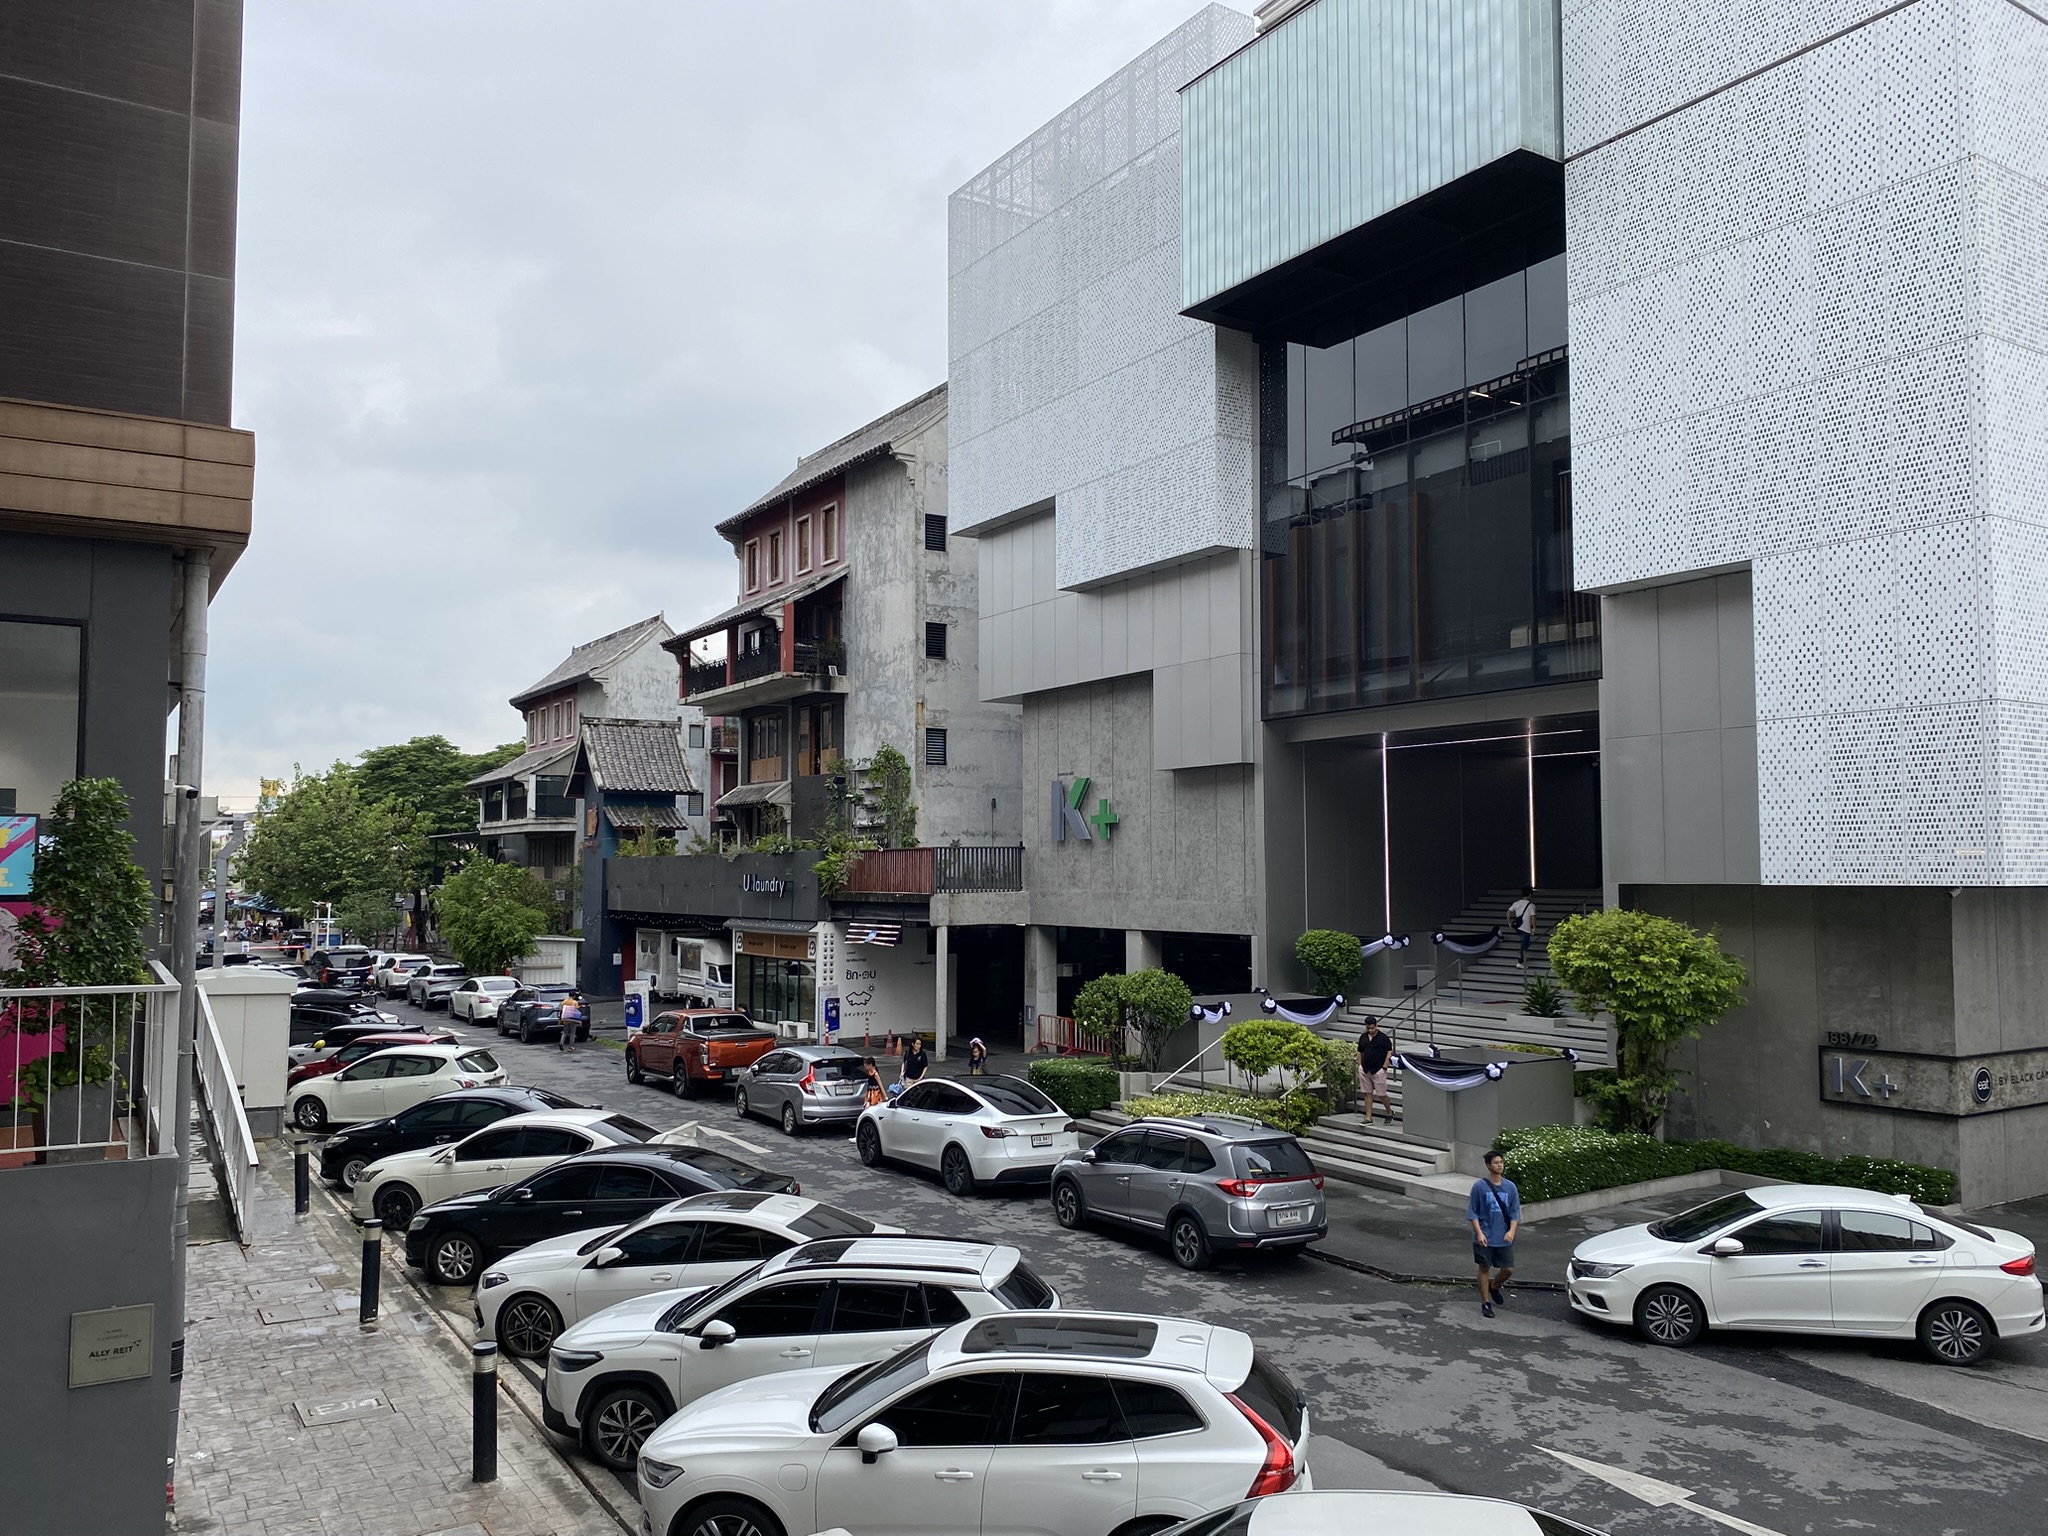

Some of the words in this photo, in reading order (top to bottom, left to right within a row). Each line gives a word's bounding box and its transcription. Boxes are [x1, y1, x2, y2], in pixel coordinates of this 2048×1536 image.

[1051, 777, 1119, 842] K+
[743, 873, 750, 892] U
[752, 874, 785, 898] laundry
[1831, 1057, 1897, 1098] K+
[1977, 1078, 1989, 1090] eat
[1998, 1076, 2009, 1086] BY
[2011, 1072, 2033, 1085] BLACK
[89, 1349, 111, 1358] ALLY
[113, 1346, 133, 1355] REIT
